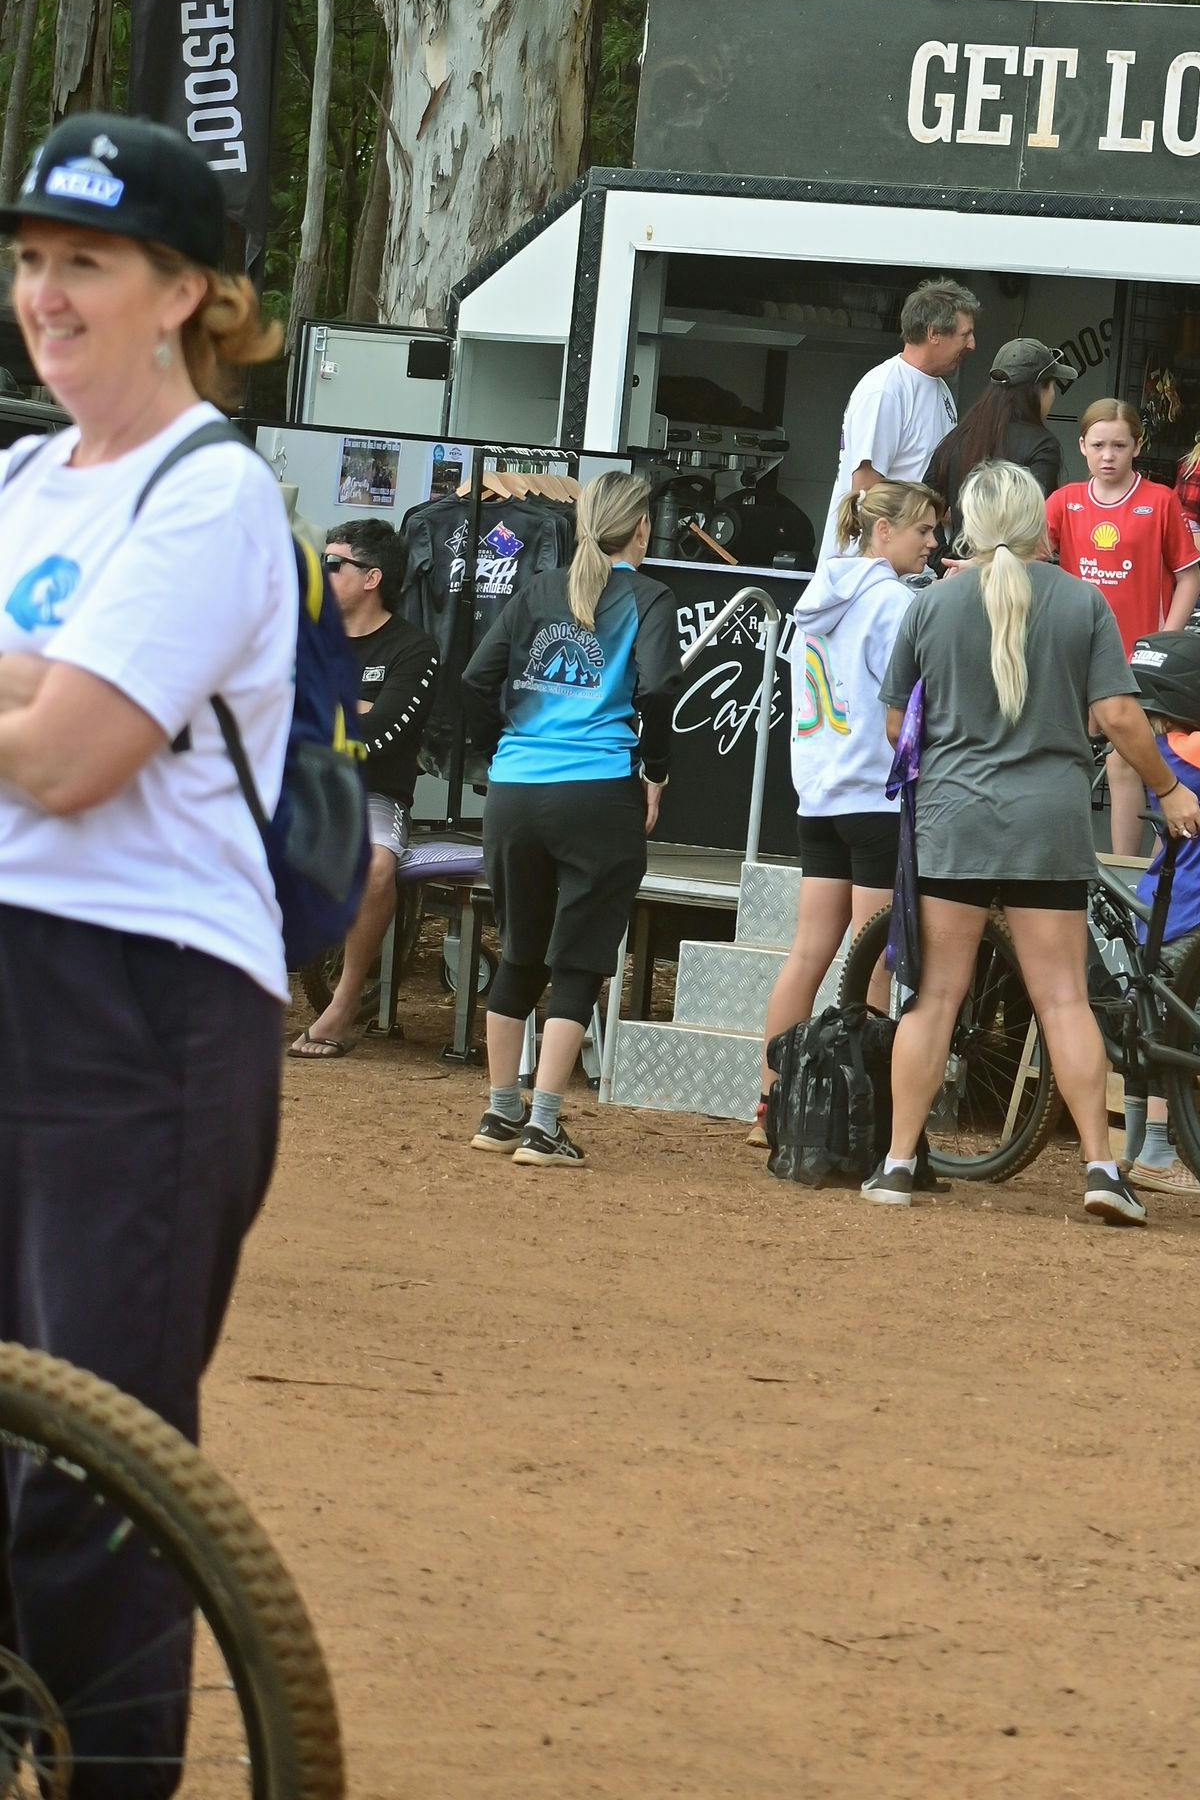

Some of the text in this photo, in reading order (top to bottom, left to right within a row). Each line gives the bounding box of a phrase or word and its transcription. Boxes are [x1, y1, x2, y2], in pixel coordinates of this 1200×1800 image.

[907, 40, 1078, 149] GET
[450, 556, 519, 587] PRTH
[1079, 565, 1129, 579] V-Power
